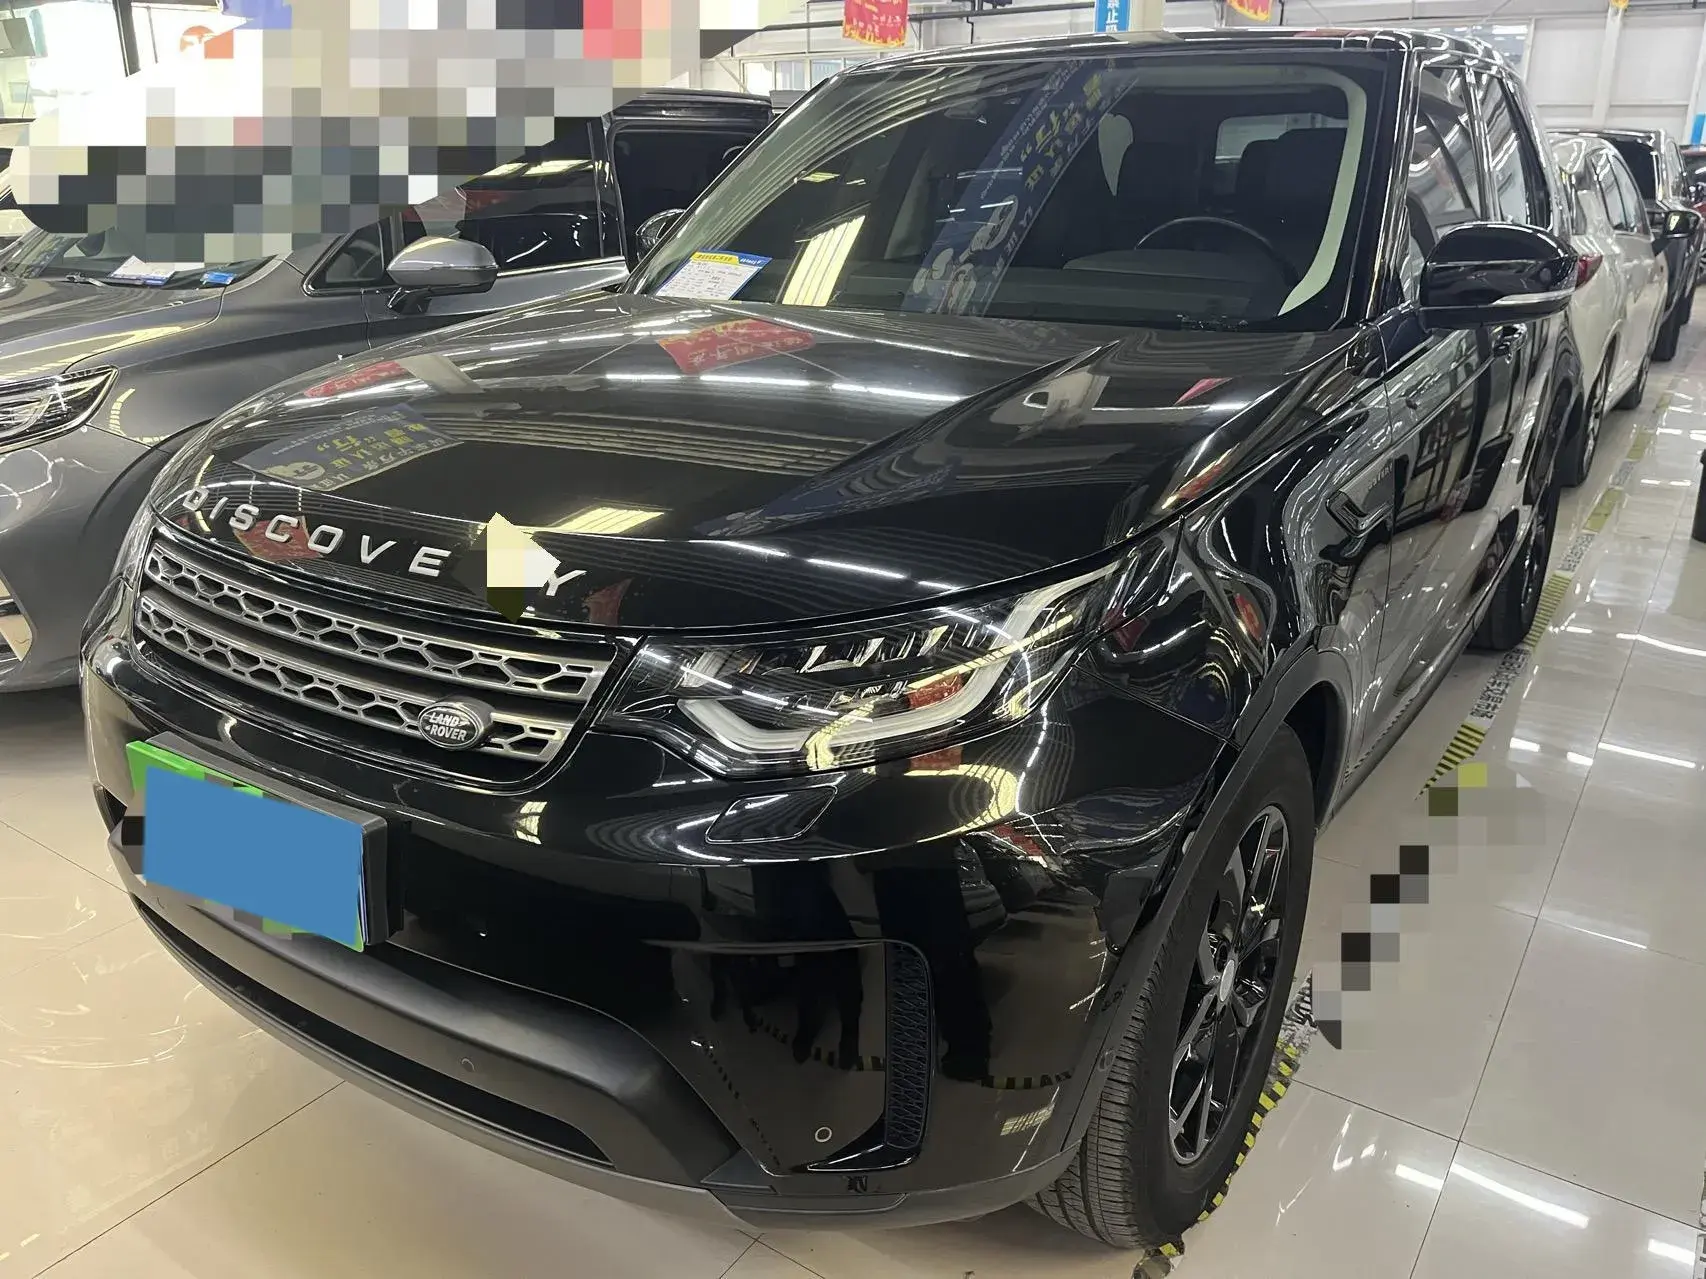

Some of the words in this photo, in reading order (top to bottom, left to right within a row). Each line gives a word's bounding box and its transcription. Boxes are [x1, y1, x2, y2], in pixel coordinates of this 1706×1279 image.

[182, 486, 587, 597] DISCOVEY
[429, 712, 461, 727] LAND
[430, 724, 467, 741] ROVER
